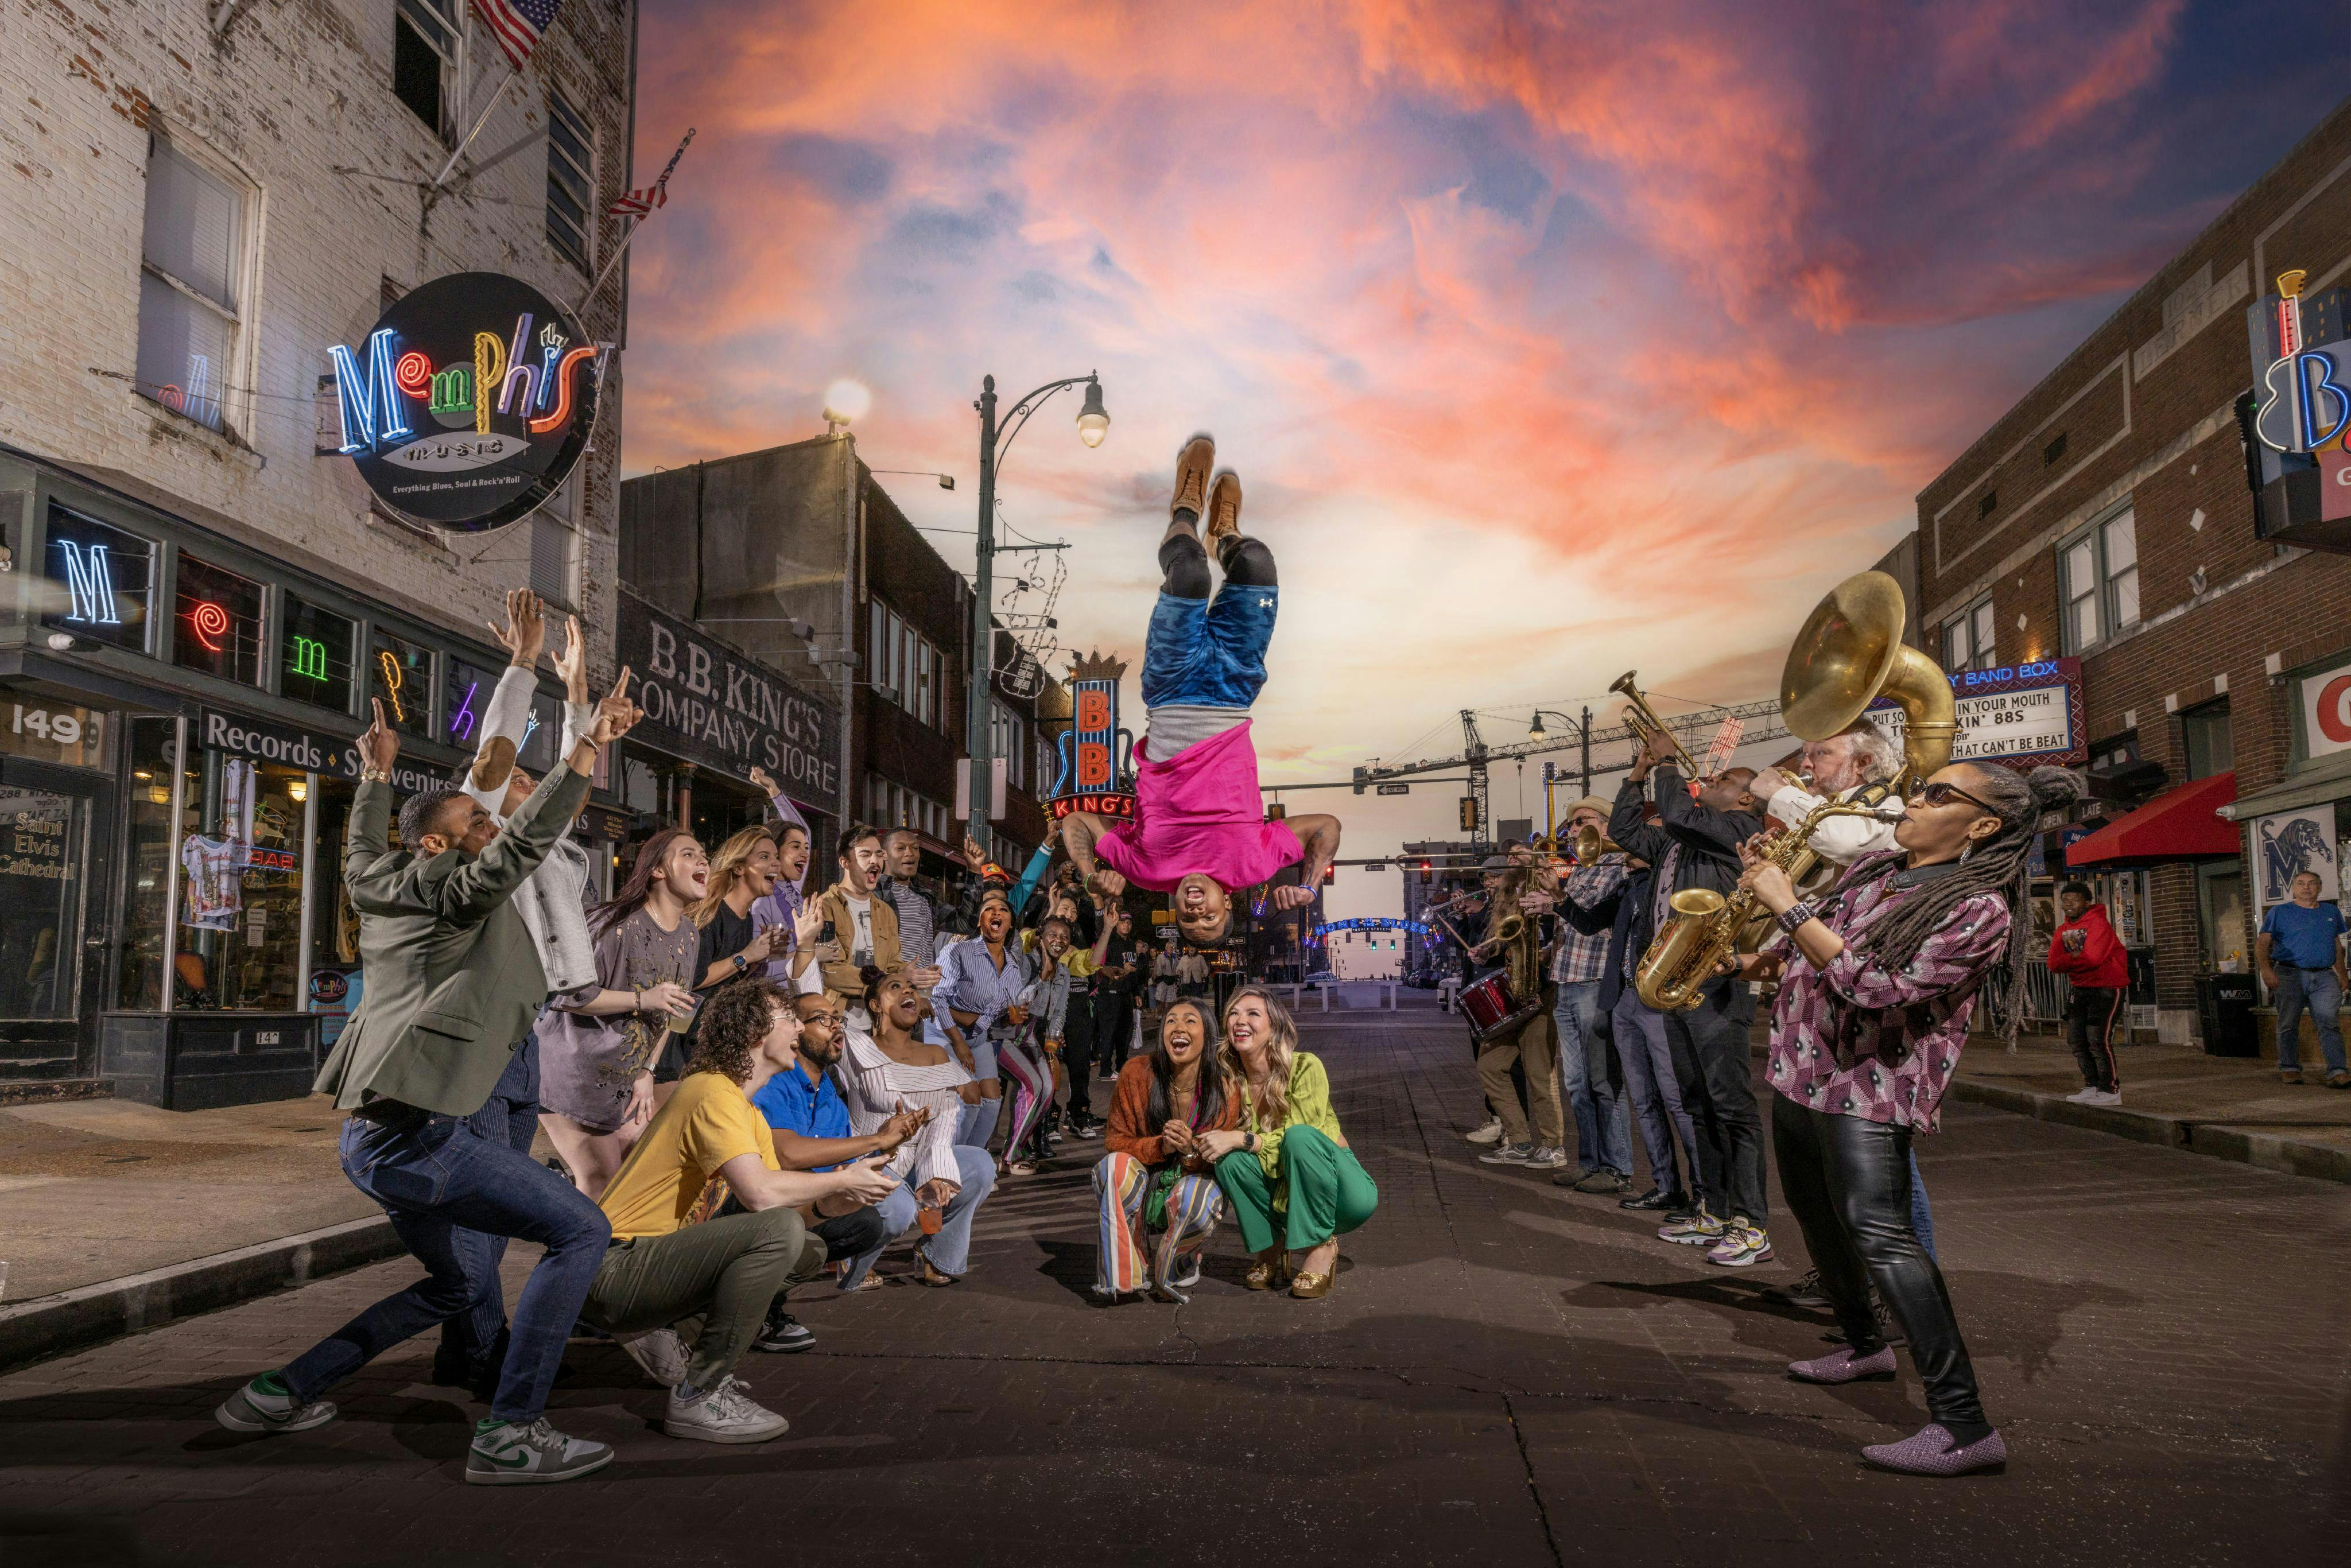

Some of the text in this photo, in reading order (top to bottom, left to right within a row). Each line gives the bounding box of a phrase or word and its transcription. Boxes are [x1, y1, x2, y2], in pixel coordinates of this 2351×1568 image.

[327, 313, 597, 453] Memphis
[393, 484, 431, 494] Everything
[432, 482, 453, 491] Blues,
[455, 480, 471, 488] Soul
[1965, 667, 2013, 686] BAND
[2019, 661, 2058, 678] BOX
[1872, 713, 1890, 725] PUT
[1958, 703, 1969, 715] IN
[1974, 697, 2007, 712] YOUR
[2011, 693, 2050, 707] MOUTH
[1994, 709, 2024, 725] 88S
[12, 704, 81, 744] 149
[207, 713, 321, 769] Records
[1982, 740, 2014, 754] CAN'T
[2019, 737, 2032, 750] BE
[2036, 734, 2065, 748] BEAT
[764, 734, 837, 795] STORE
[1054, 797, 1133, 818] KING'S
[2043, 802, 2101, 828] OPEN LATE
[15, 812, 63, 836] Saint
[14, 835, 60, 857] Elvis
[1315, 918, 1360, 936] HOME
[1380, 918, 1429, 935] BLUES
